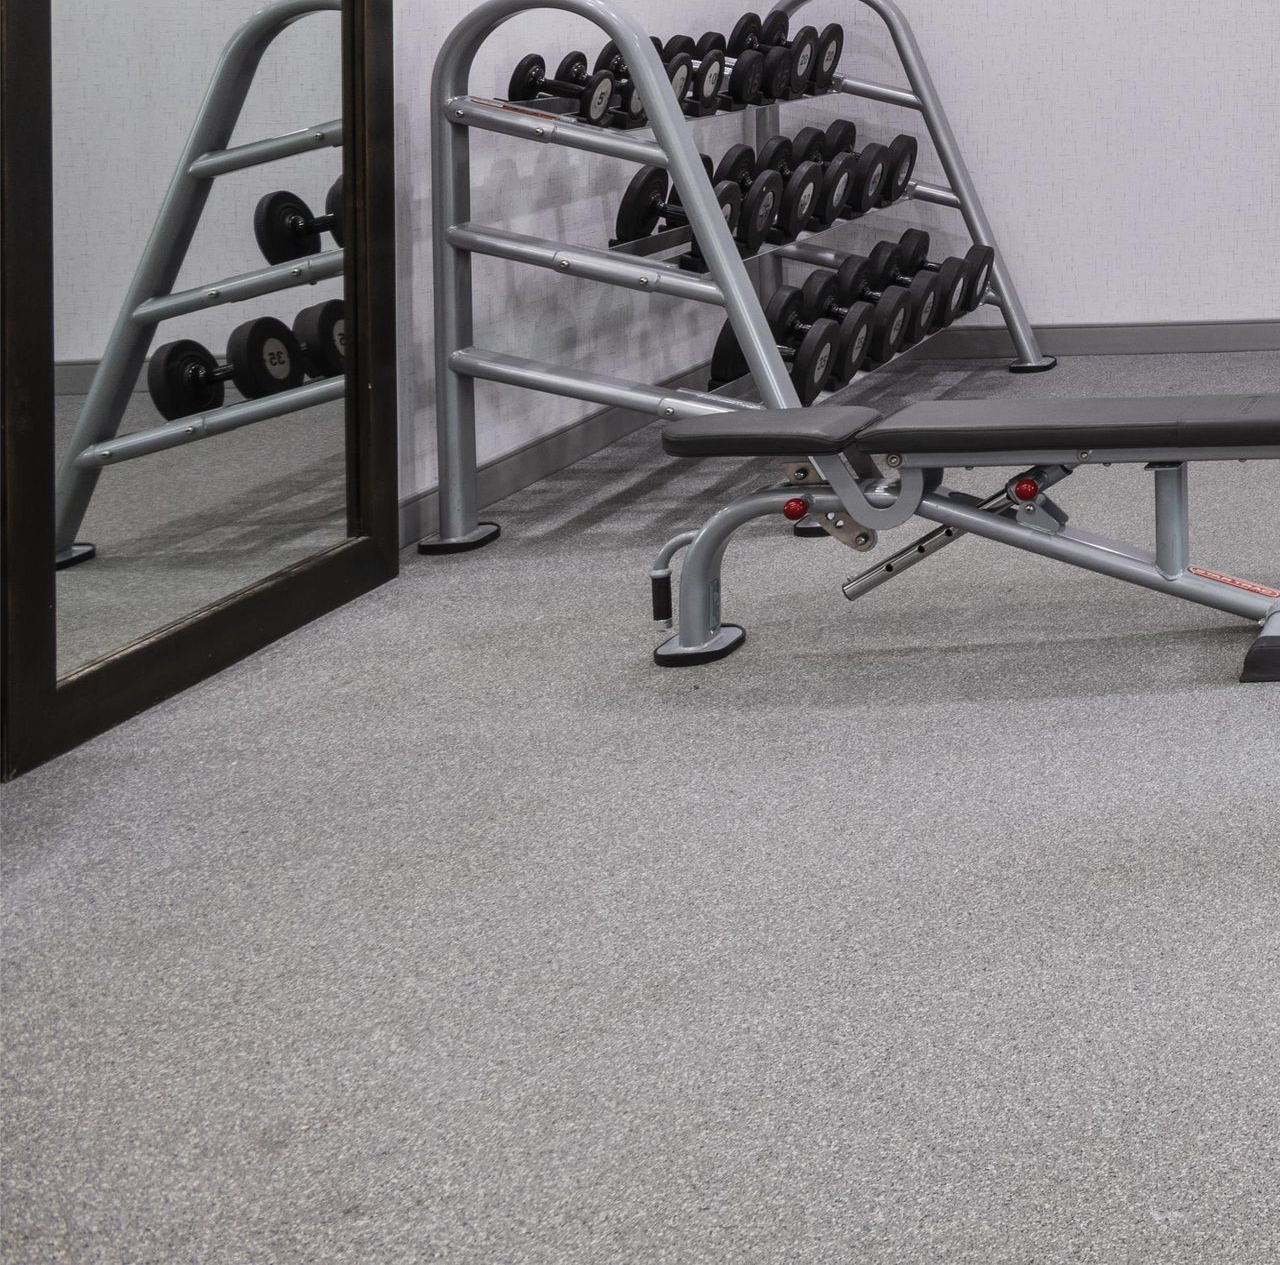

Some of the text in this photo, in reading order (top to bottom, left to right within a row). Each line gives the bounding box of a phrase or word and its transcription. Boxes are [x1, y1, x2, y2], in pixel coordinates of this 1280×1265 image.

[709, 72, 718, 86] 10
[597, 92, 606, 106] 5
[817, 353, 828, 371] 35
